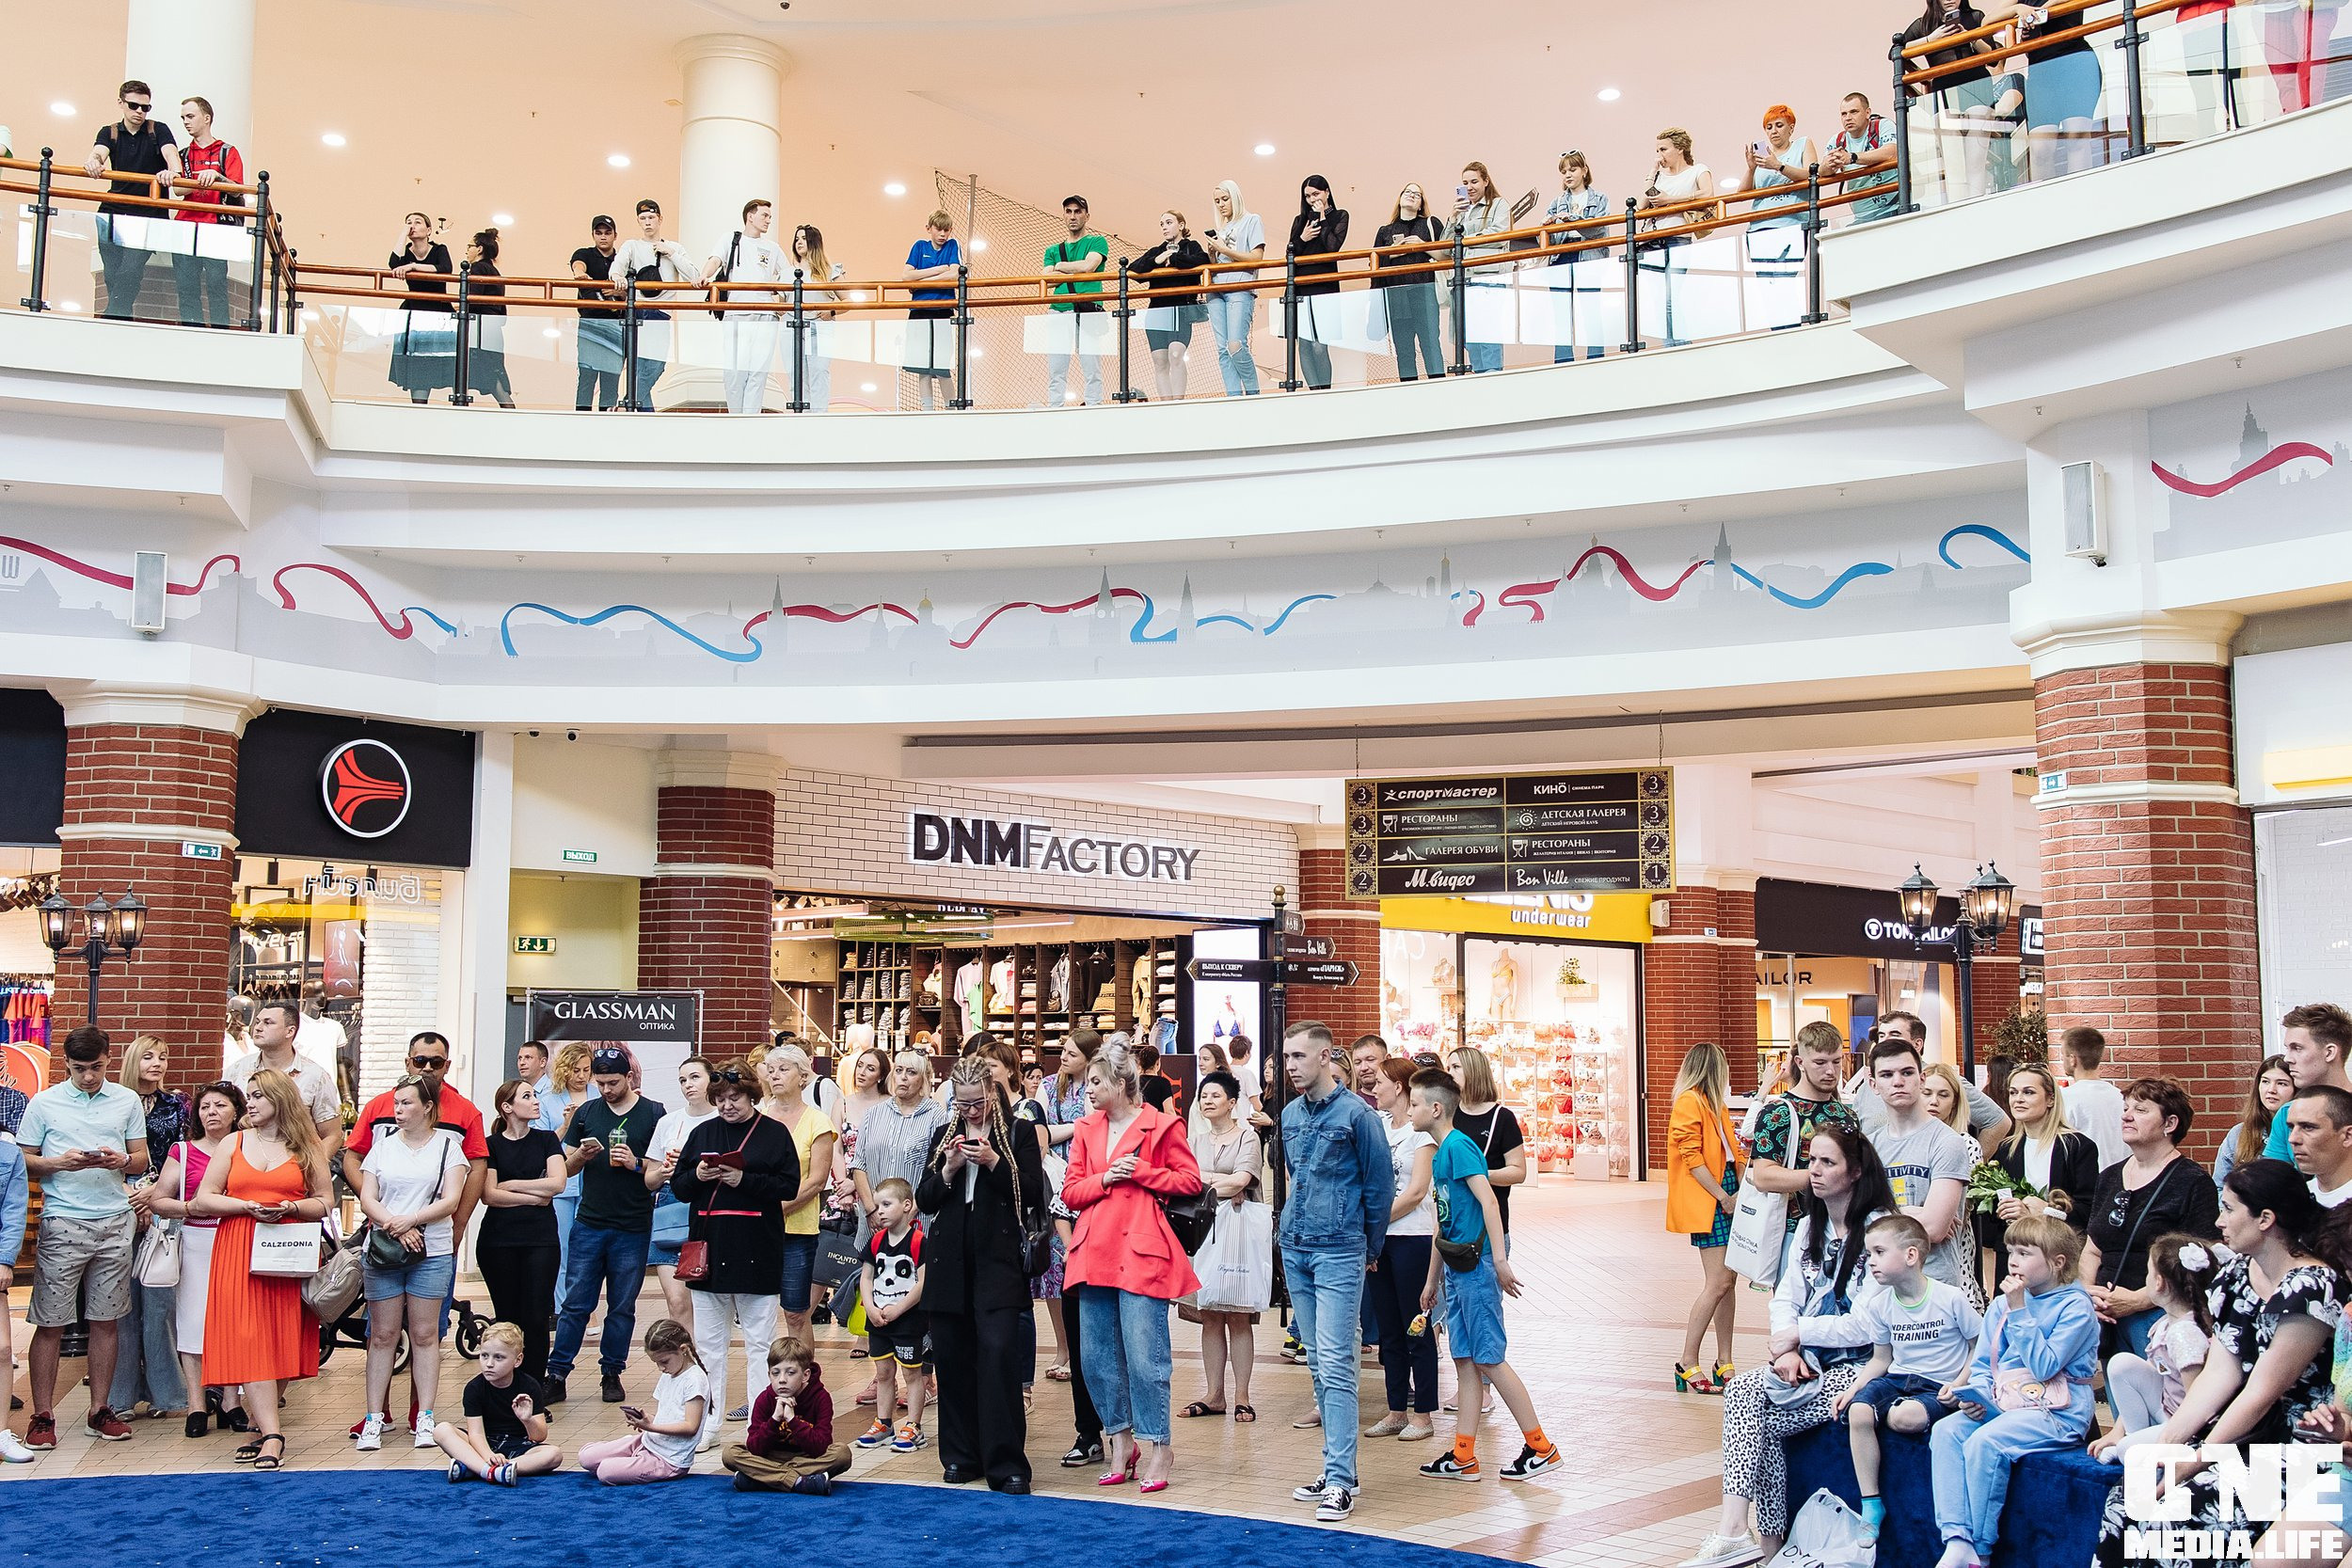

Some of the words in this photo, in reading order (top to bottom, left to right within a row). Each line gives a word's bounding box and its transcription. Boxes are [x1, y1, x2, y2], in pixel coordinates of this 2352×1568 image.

[1649, 776, 1658, 790] 3
[1359, 788, 1366, 801] 3
[1541, 809, 1584, 819] ДЕТСКАЯ
[1586, 808, 1626, 816] ГАЛЕРЕЯ
[1650, 805, 1659, 819] 3
[1359, 816, 1366, 830] 3
[1402, 815, 1458, 824] РЕСТОРАНЫ
[1532, 839, 1590, 848] РЕСТОРАНЫ
[1651, 835, 1660, 848] 2
[566, 851, 595, 861] ВЫХОД
[1359, 845, 1366, 858] 2
[1425, 847, 1463, 855] ГАЛЕРЕЯ
[1465, 846, 1499, 855] ОБУВИ
[1517, 869, 1540, 886] Bon
[1543, 869, 1569, 884] Ville
[1652, 864, 1658, 879] 1
[1359, 873, 1367, 886] 2
[1511, 909, 1592, 927] underwear
[554, 1002, 675, 1021] GLASSMAN
[640, 1022, 675, 1030] ОПТИКА
[828, 1251, 858, 1264] INCANTO
[1893, 1330, 1939, 1341] TRAINING
